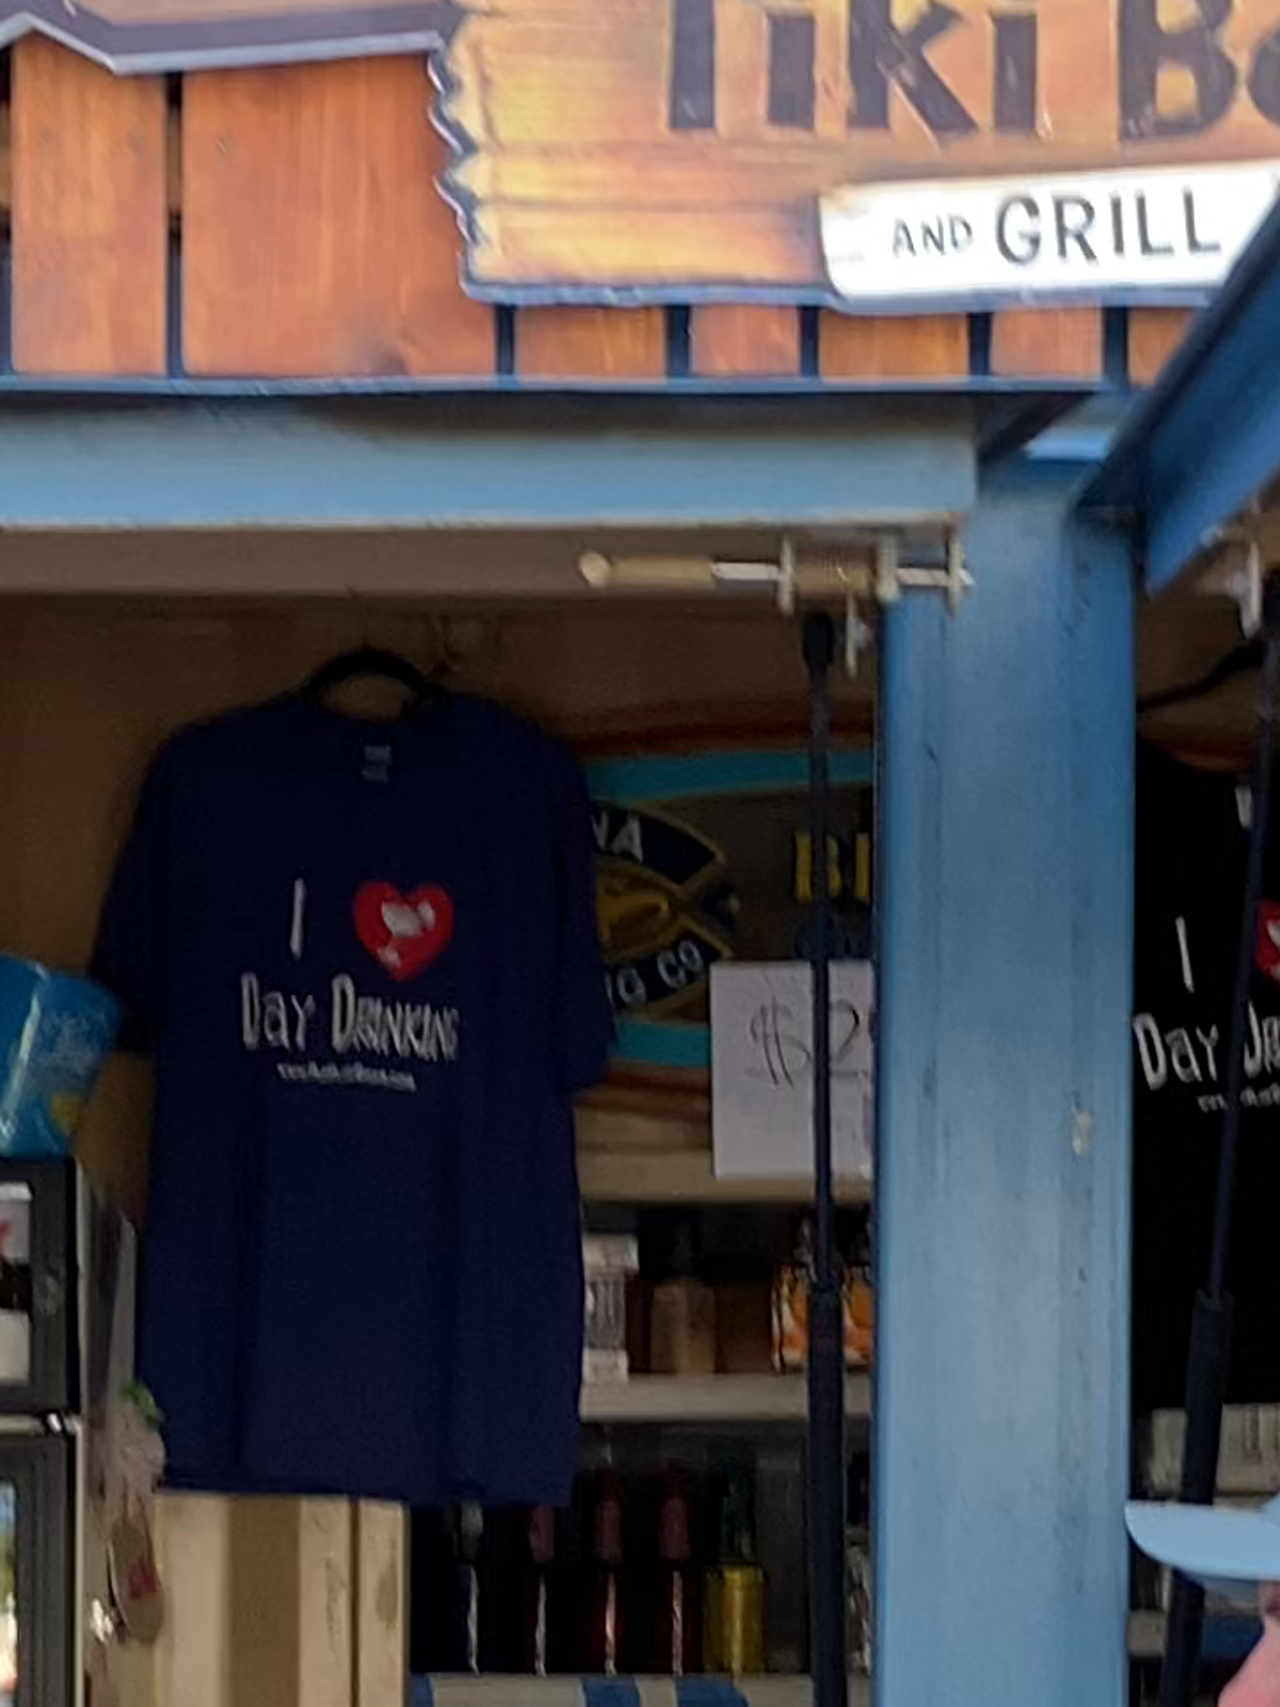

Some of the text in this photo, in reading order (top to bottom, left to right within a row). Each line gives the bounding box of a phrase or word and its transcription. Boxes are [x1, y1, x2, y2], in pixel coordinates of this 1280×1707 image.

[892, 191, 1222, 267] AND GRILL
[290, 876, 307, 961] I
[1175, 914, 1195, 994] I
